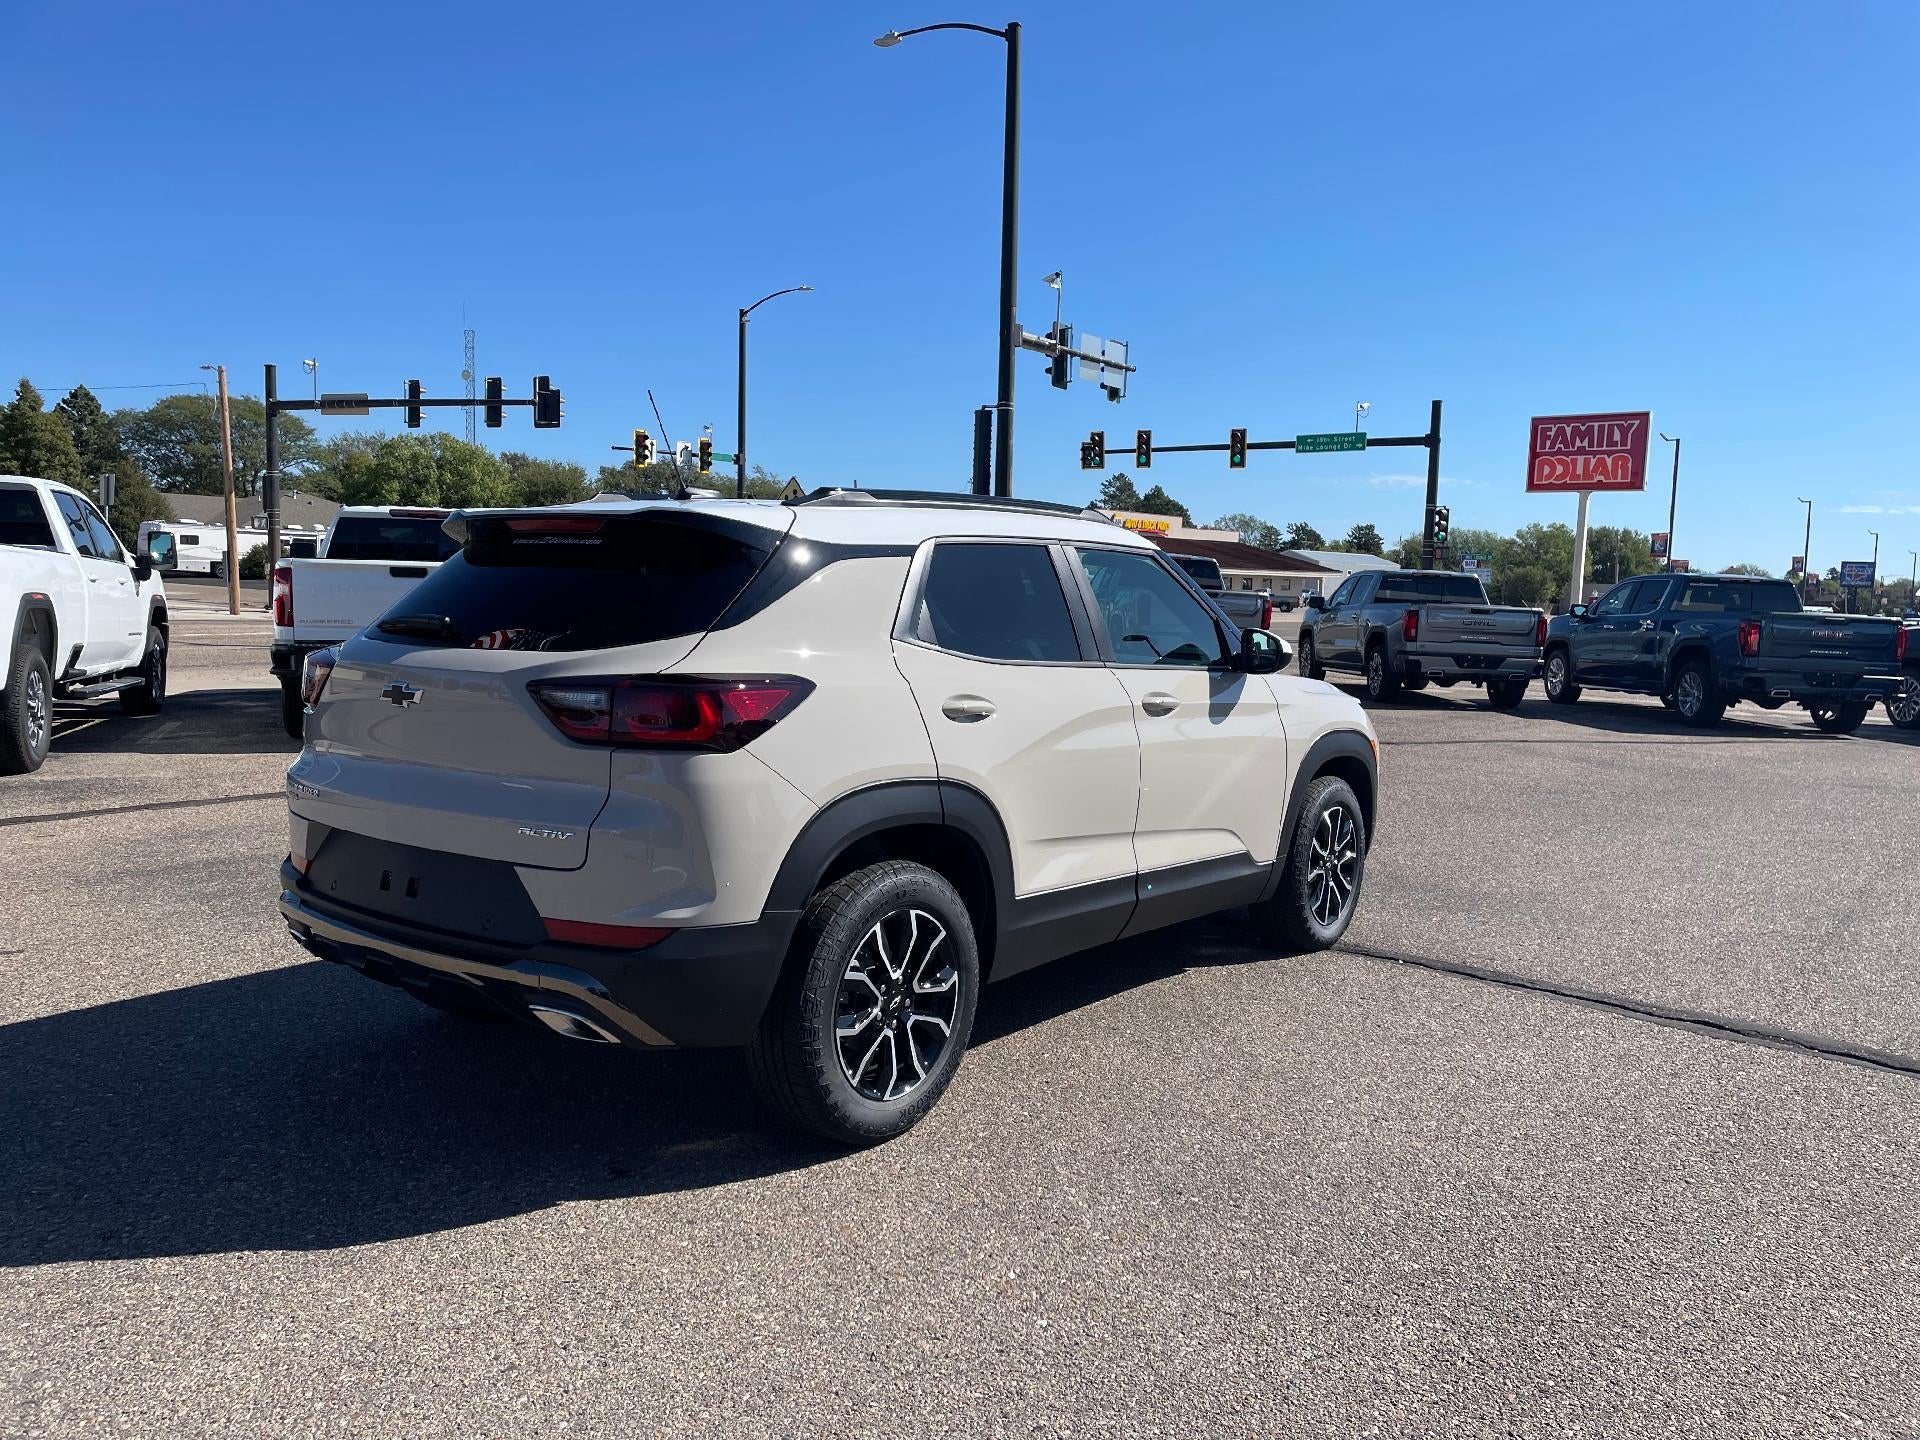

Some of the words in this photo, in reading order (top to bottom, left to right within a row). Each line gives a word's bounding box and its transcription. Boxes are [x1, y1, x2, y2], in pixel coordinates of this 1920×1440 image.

[1536, 420, 1640, 452] FAMILY
[1534, 453, 1632, 484] DOLLAR
[1463, 618, 1497, 627] GMC
[517, 826, 575, 840] ACTIV
